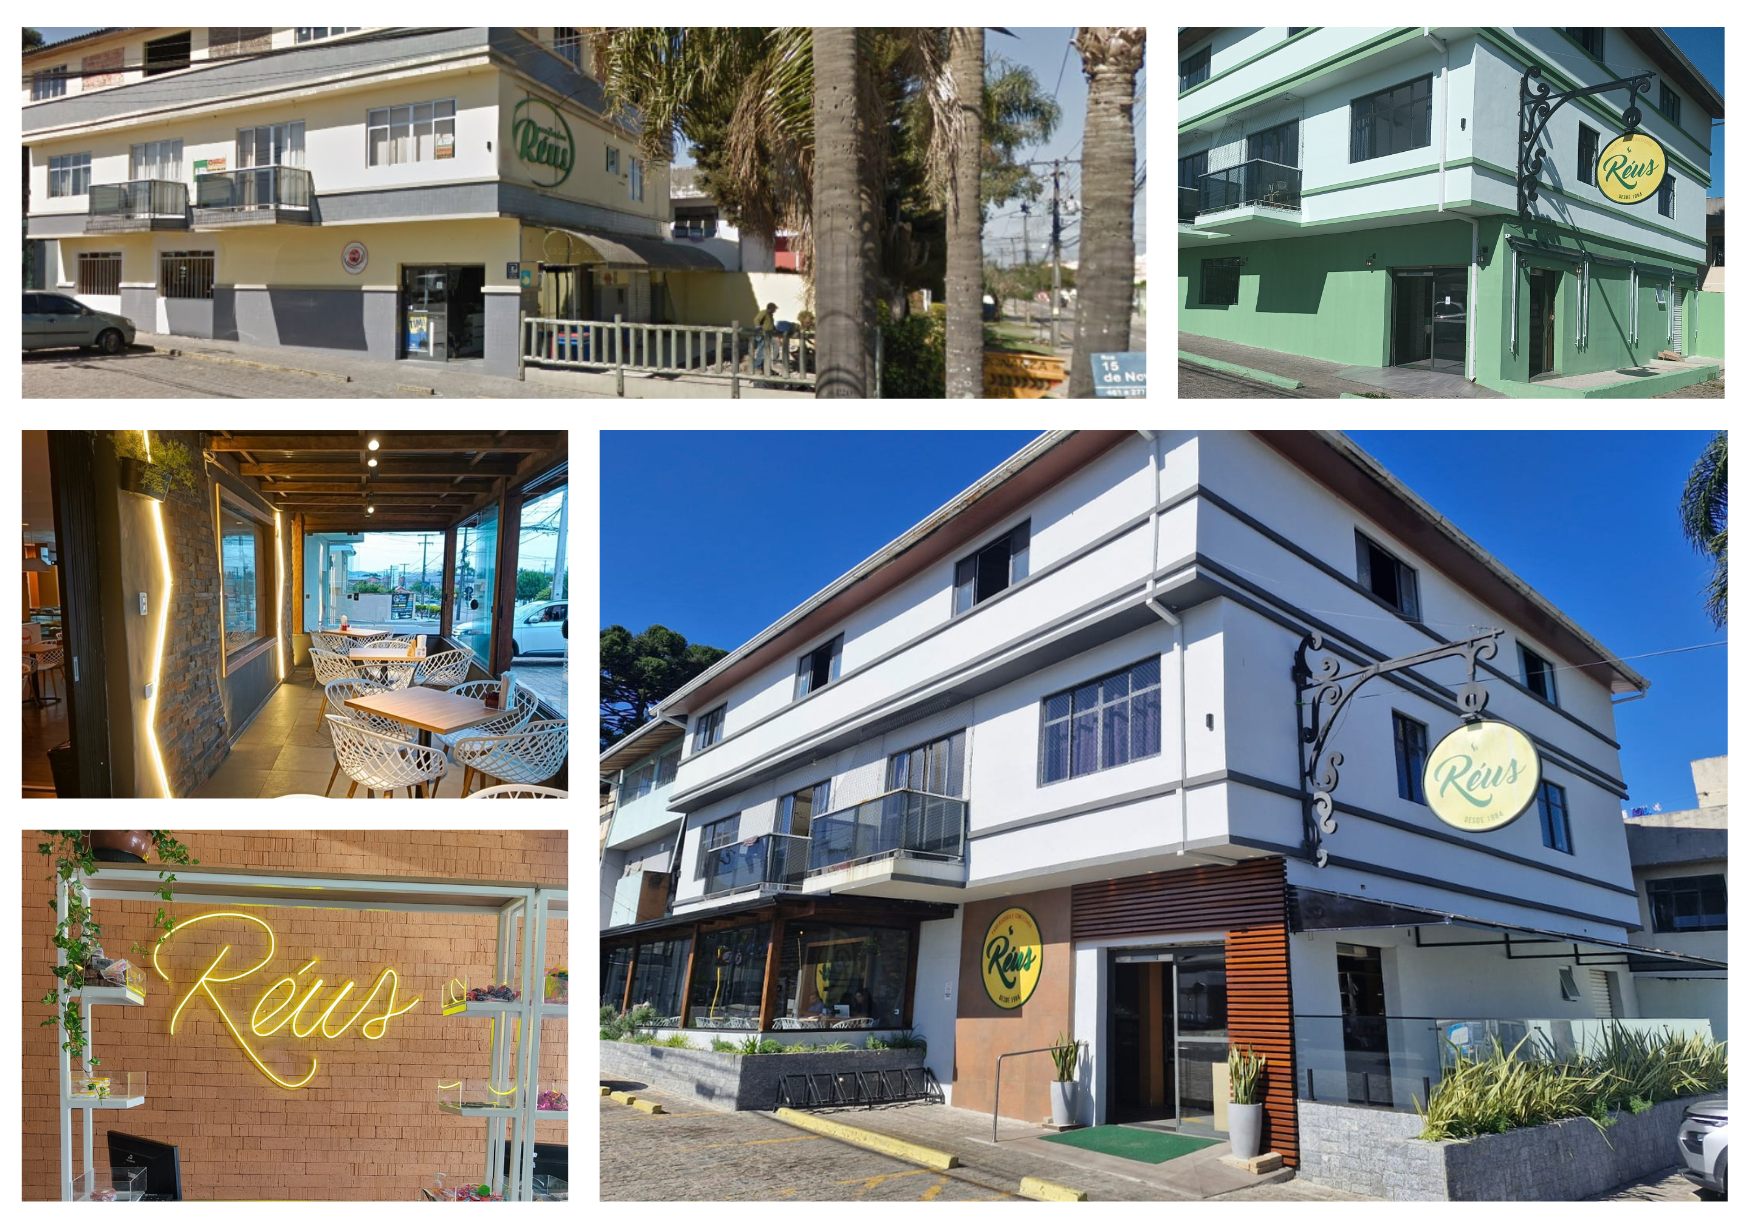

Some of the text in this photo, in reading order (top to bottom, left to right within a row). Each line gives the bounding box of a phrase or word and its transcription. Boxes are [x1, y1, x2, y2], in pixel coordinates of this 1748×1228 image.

[515, 118, 570, 171] Réus
[1603, 154, 1660, 190] Réus
[1101, 360, 1120, 371] 15
[1103, 372, 1122, 383] de
[1434, 754, 1527, 808] Réus
[1464, 815, 1485, 824] DESDE
[986, 935, 1037, 989] Réus
[153, 911, 421, 1089] Réus
